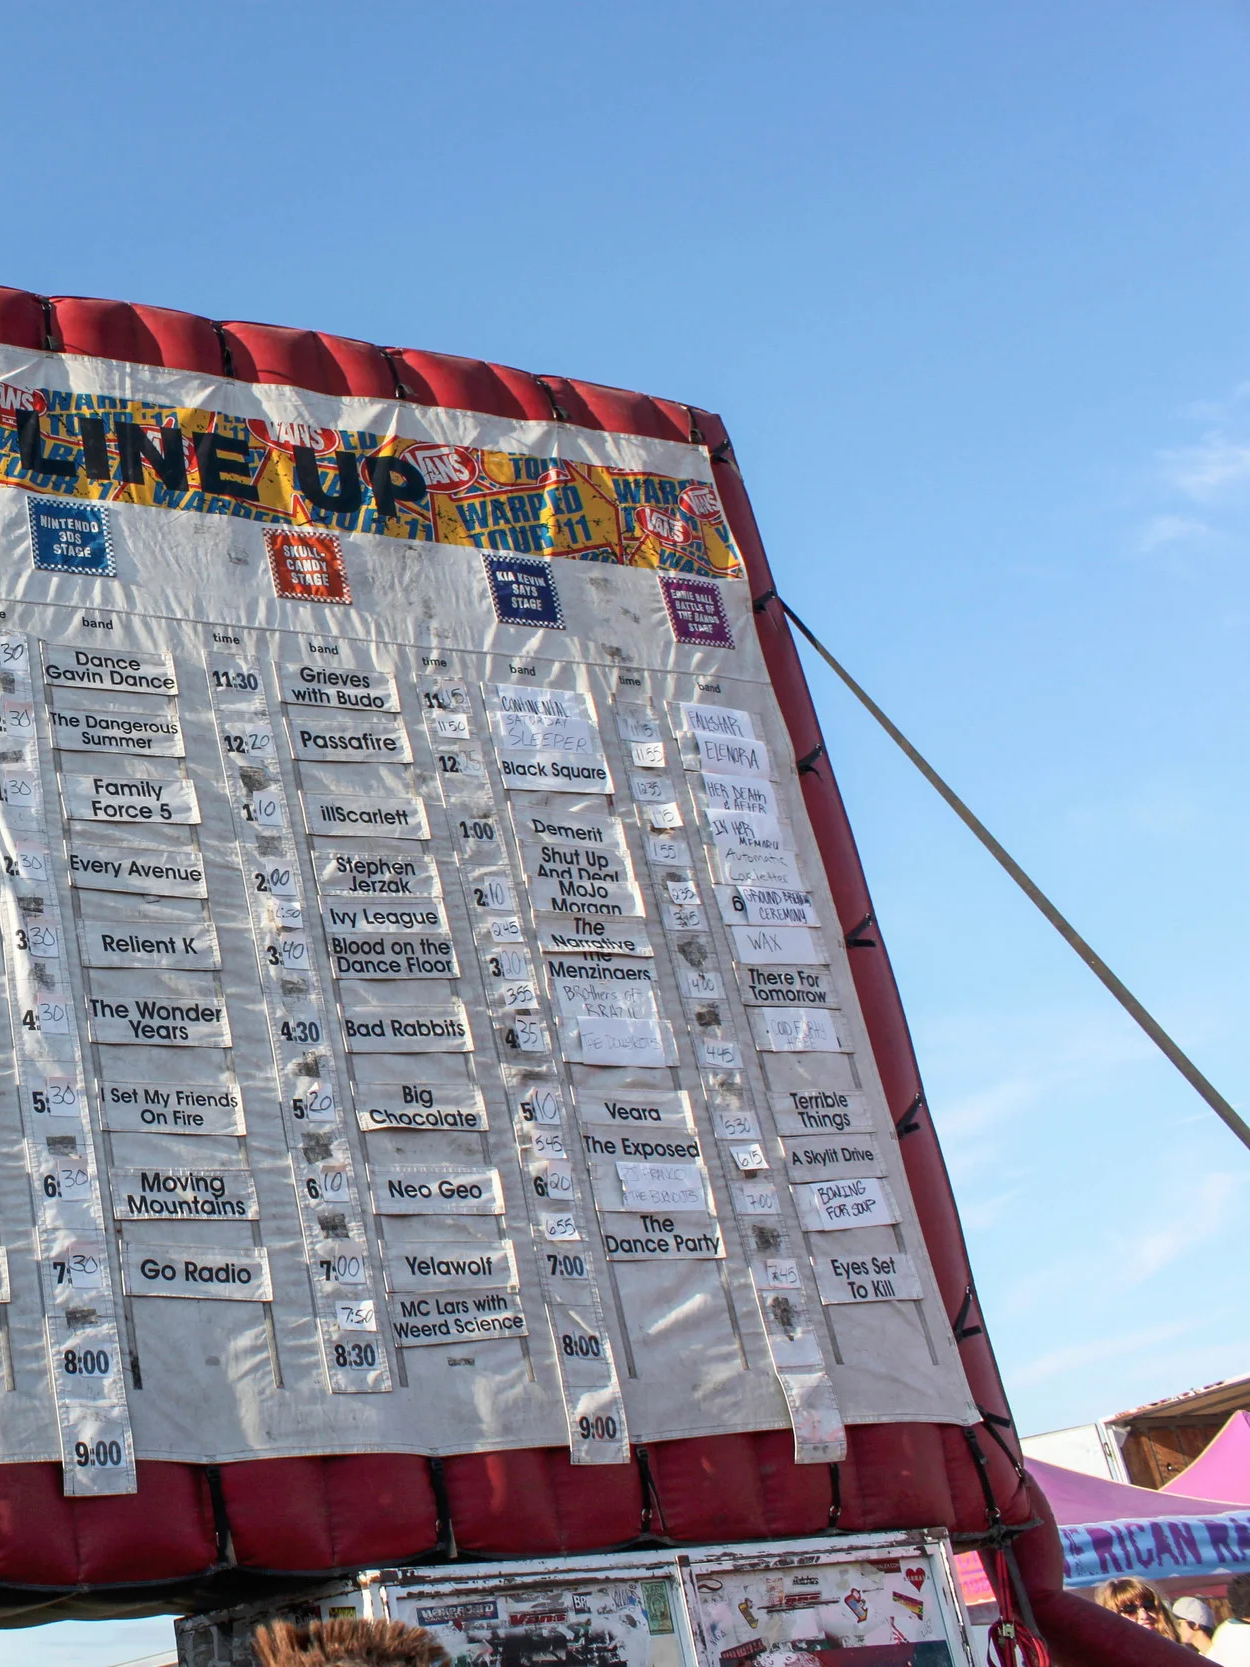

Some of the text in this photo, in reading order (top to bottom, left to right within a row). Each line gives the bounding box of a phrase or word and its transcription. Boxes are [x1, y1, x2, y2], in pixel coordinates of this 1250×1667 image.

[16, 409, 260, 501] LINE
[293, 446, 427, 517] UP
[40, 515, 99, 533] NINTENDO
[59, 531, 82, 545] 3DS
[53, 543, 91, 558] STAGE
[284, 544, 326, 559] SKULL-
[287, 558, 327, 573] CANDY
[291, 572, 329, 587] STAGE
[496, 570, 546, 587] KIA KEVIN
[512, 584, 538, 598] SAYS
[512, 597, 542, 612] STAGE
[75, 651, 141, 671] Dance
[46, 665, 175, 689] Gavin Dance
[300, 667, 370, 688] Grieves
[292, 688, 384, 708] with Budo
[300, 730, 397, 751] Passafire
[502, 761, 607, 780] Black Square
[320, 806, 409, 825] illScarlett
[70, 855, 201, 882] Every Avenue
[101, 934, 198, 955] Relient K
[749, 968, 820, 988] There For
[749, 986, 826, 1003] Tomorrow
[90, 999, 222, 1023] The Wonder
[129, 1020, 189, 1040] Years
[346, 1019, 465, 1037] Bad Rabbits
[790, 1092, 848, 1110] Terrible
[604, 1102, 661, 1121] Veara
[798, 1112, 850, 1130] Things
[583, 1135, 700, 1159] The Exposed
[141, 1172, 225, 1196] Moving
[388, 1180, 482, 1199] Neo Geo
[127, 1194, 246, 1216] Mountains
[640, 1215, 674, 1233] The
[605, 1234, 720, 1254] Dance Party
[140, 1259, 252, 1285] Go Radio
[405, 1256, 492, 1276] Yelawolf
[831, 1257, 896, 1280] Eyes Set
[848, 1280, 896, 1299] To Kill
